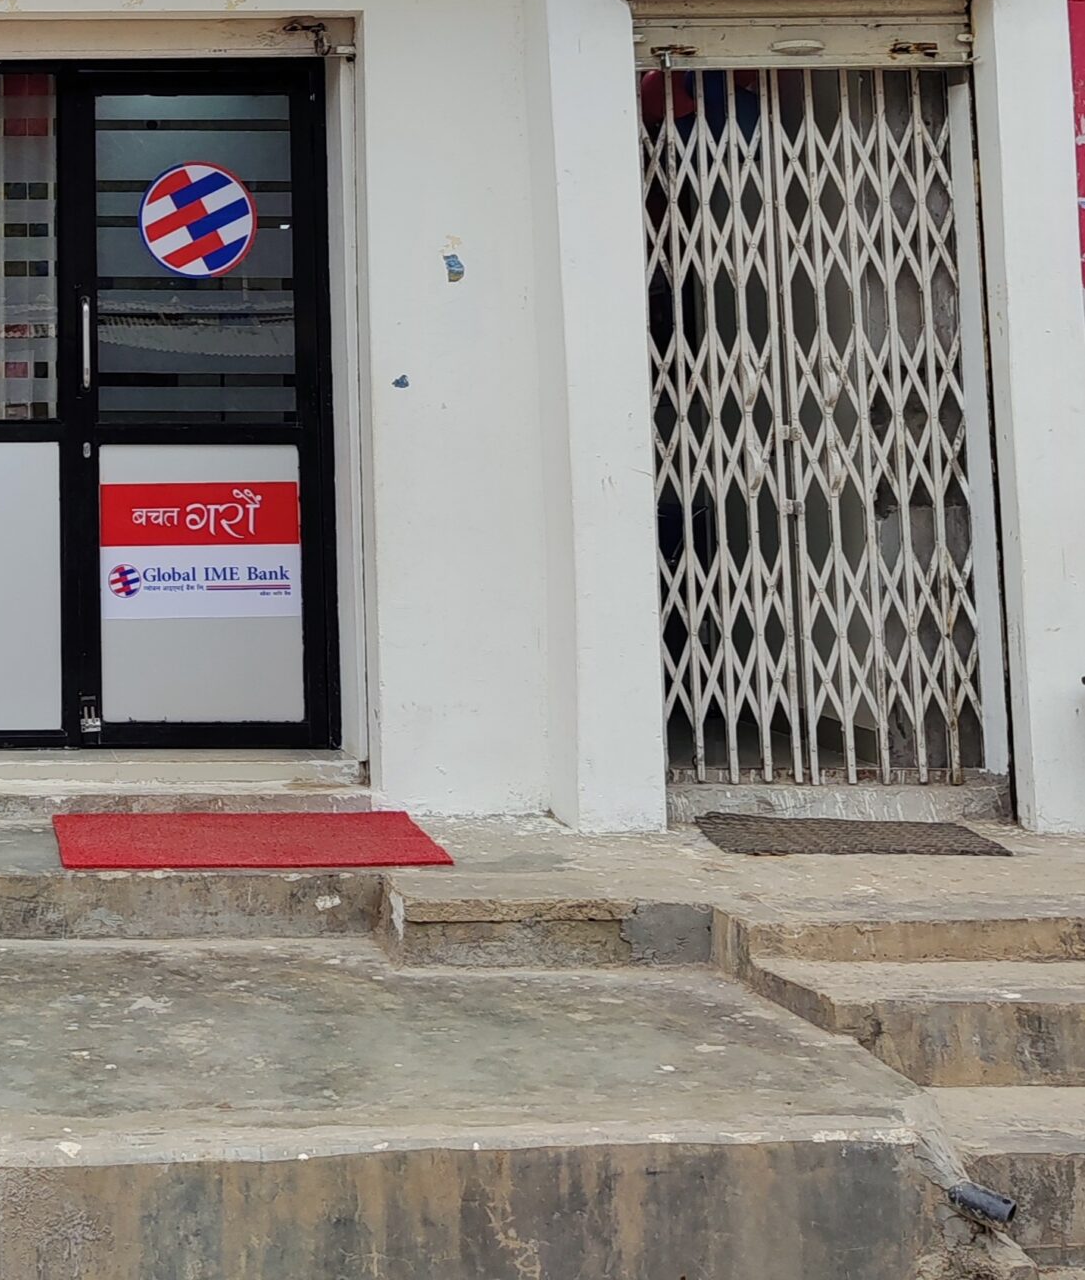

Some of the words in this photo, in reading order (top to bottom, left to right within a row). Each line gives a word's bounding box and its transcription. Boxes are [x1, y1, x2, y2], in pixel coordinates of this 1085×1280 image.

[131, 507, 181, 527] बचत
[142, 567, 197, 582] Global
[203, 566, 241, 581] IME
[246, 565, 290, 581] Bank
